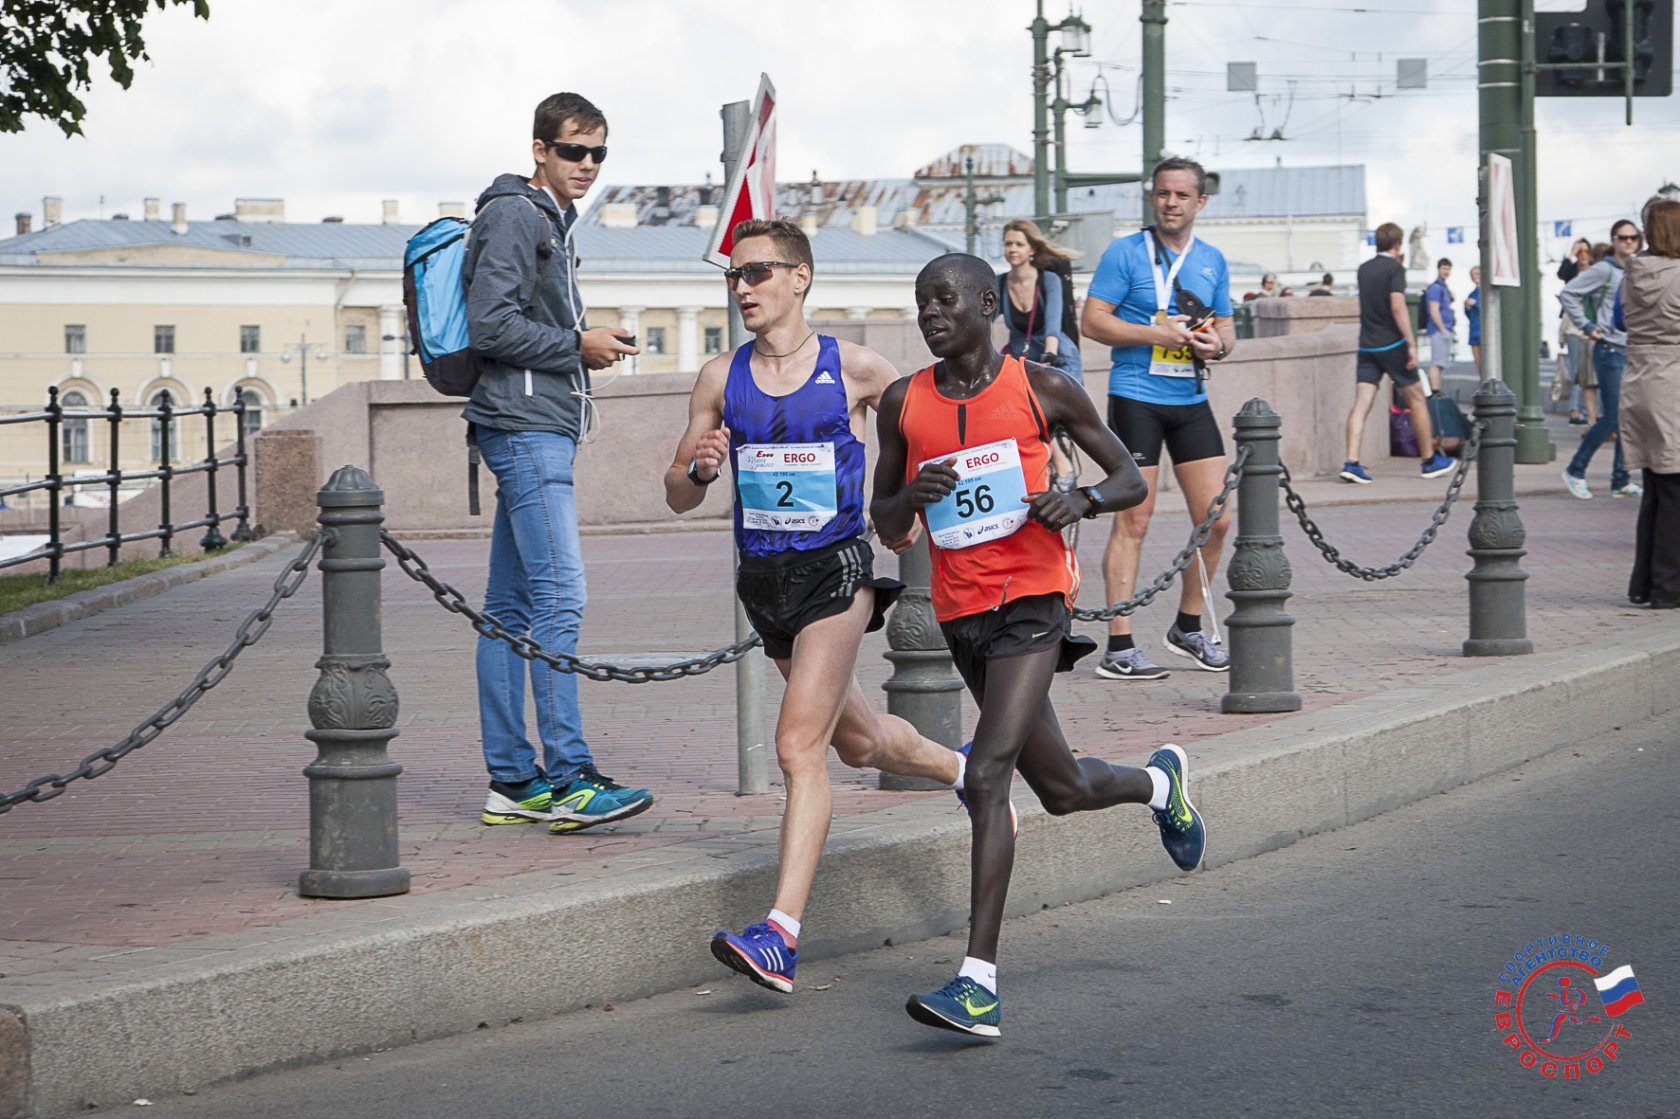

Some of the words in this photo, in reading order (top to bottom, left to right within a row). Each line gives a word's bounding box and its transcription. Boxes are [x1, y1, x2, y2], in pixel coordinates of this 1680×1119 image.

[784, 453, 816, 463] ERGO
[966, 452, 999, 468] ERGO
[776, 481, 794, 507] 2
[956, 485, 994, 518] 56
